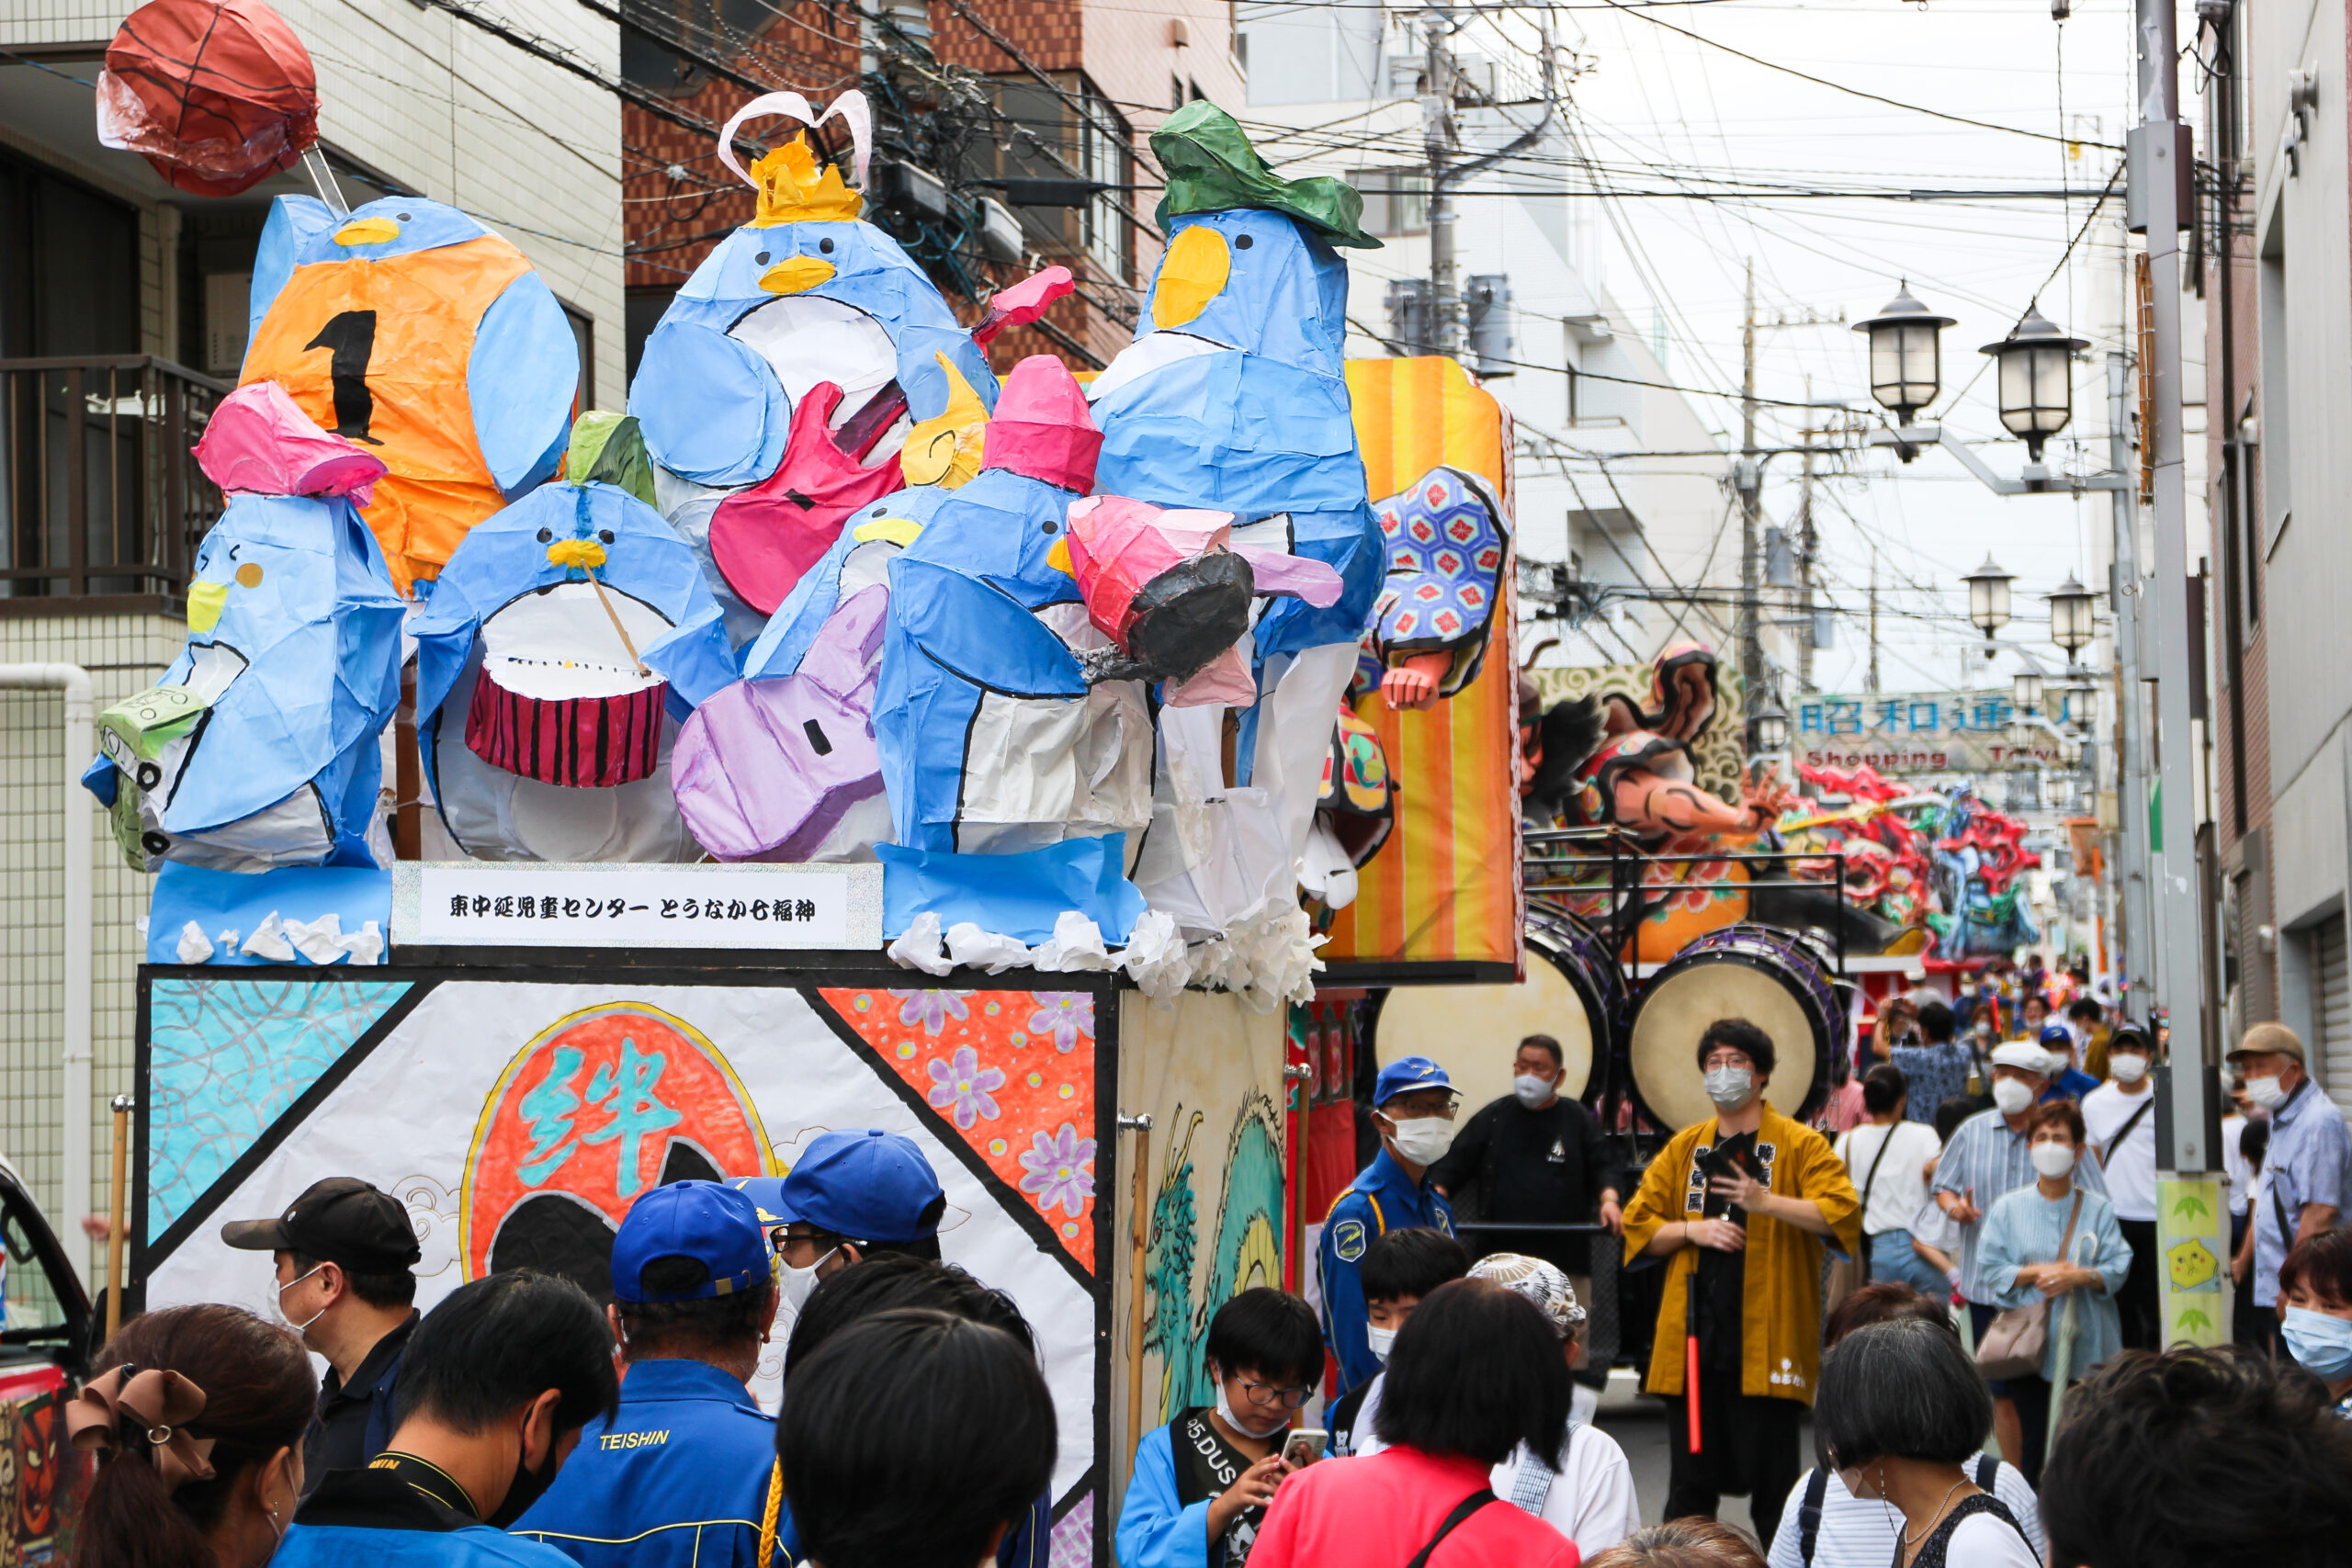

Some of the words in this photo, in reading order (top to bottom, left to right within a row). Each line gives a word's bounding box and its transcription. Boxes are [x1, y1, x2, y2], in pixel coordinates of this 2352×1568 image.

[302, 310, 385, 446] 1
[1806, 749, 1948, 769] Shopping
[450, 895, 650, 919] 東中延児童センター
[661, 898, 815, 921] とうなか七福神
[516, 1037, 683, 1198] 絆
[600, 1430, 670, 1450] TEISHIN
